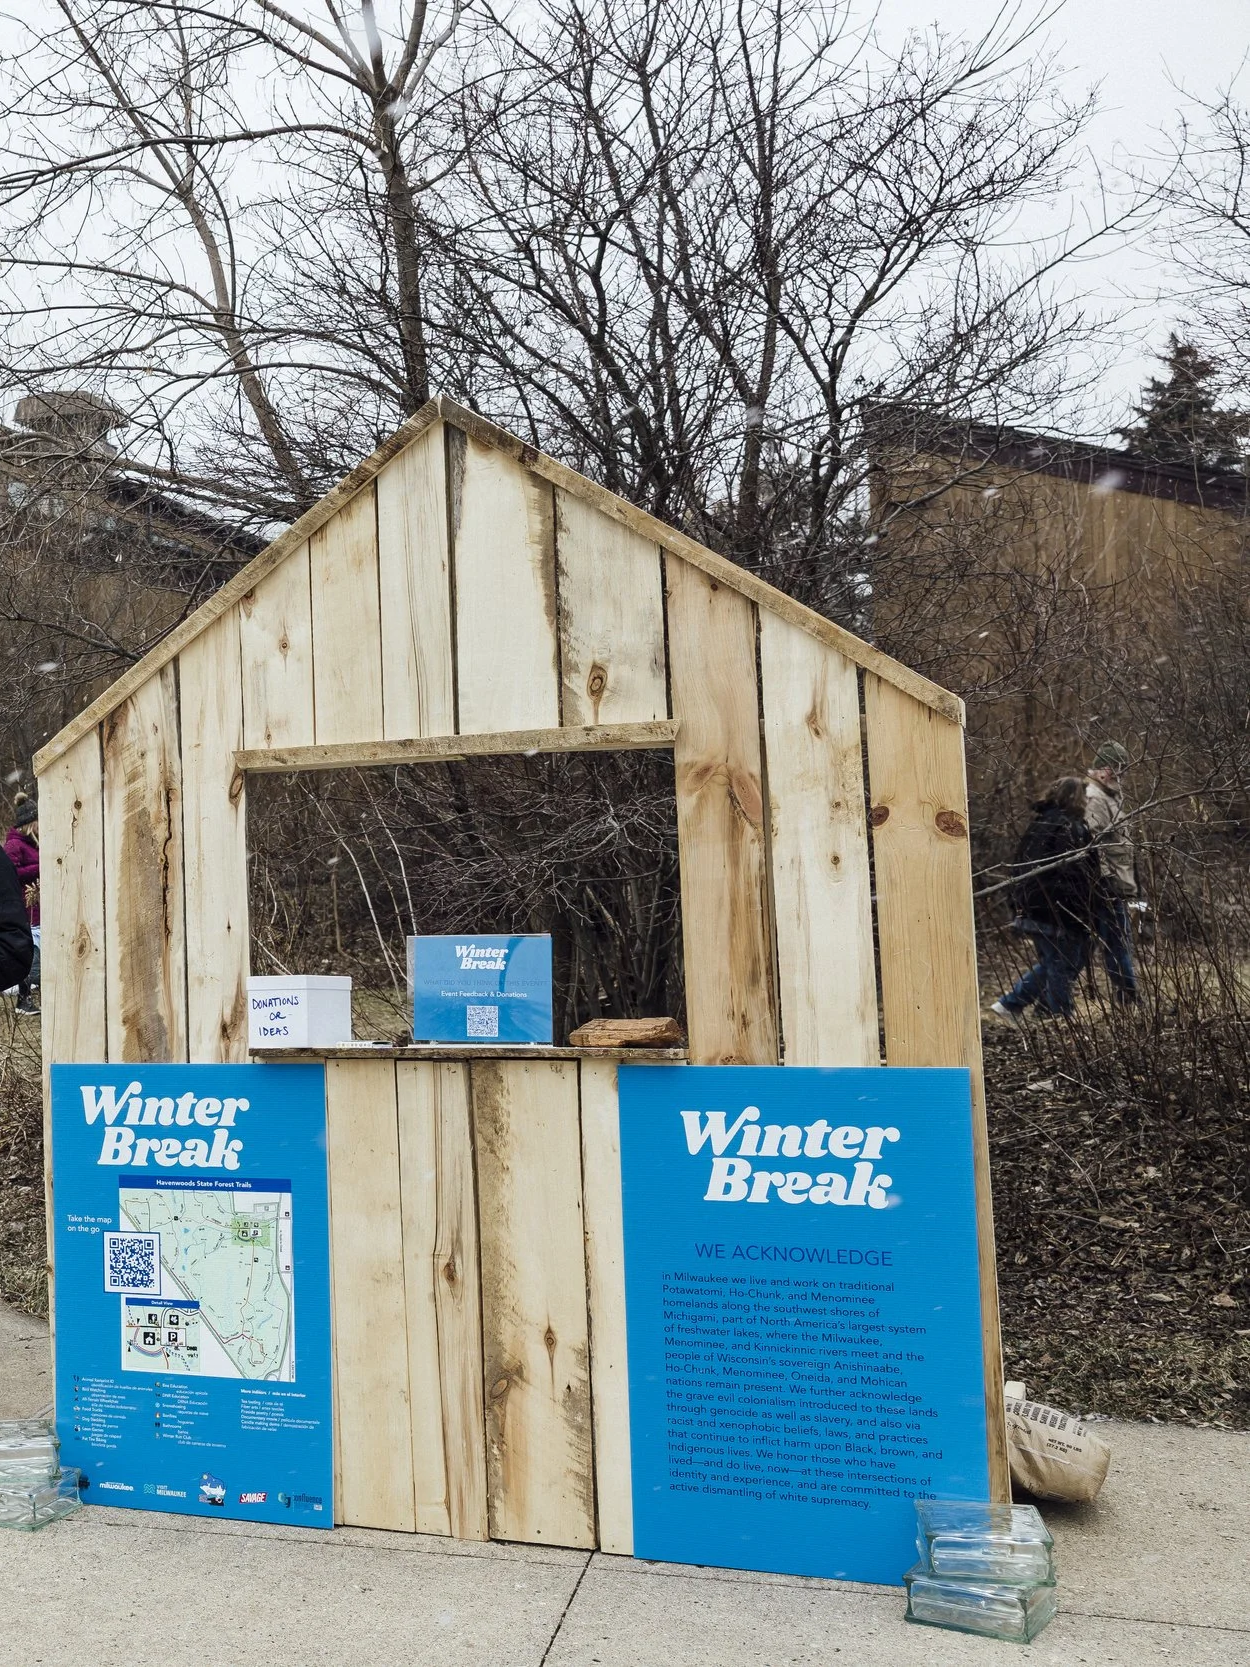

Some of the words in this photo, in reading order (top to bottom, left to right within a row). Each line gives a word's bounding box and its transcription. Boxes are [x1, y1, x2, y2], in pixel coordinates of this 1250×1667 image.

[455, 944, 508, 958] Winter
[460, 958, 507, 970] Break
[252, 996, 299, 1010] DONATIONS
[259, 1026, 289, 1036] IDEAS
[80, 1080, 250, 1126] Winter
[680, 1106, 900, 1160] Winter
[97, 1126, 244, 1170] Break
[703, 1156, 893, 1210] Break
[67, 1214, 82, 1222] Take
[695, 1243, 726, 1259] WE
[732, 1244, 893, 1266] ACKNOWLEDGE
[662, 1284, 725, 1296] Potawatomi,
[729, 1287, 784, 1300] Ho-Chunk,
[787, 1291, 807, 1300] and
[810, 1291, 874, 1303] Menominee
[674, 1271, 728, 1283] Milwaukee
[749, 1275, 766, 1285] live
[770, 1276, 789, 1286] and
[792, 1278, 818, 1287] work
[838, 1280, 894, 1291] traditional
[662, 1297, 718, 1309] homelands
[721, 1300, 750, 1313] along
[753, 1302, 770, 1312] the
[773, 1303, 826, 1315] southwest
[829, 1306, 865, 1317] shores
[868, 1307, 879, 1318] of
[663, 1310, 718, 1324] Michigami,
[722, 1315, 743, 1325] part
[745, 1315, 756, 1324] of
[760, 1316, 790, 1326] North
[848, 1320, 884, 1333] largest
[888, 1324, 926, 1336] system
[663, 1323, 675, 1332] of
[676, 1323, 730, 1335] freshwater
[733, 1327, 762, 1339] lakes,
[765, 1329, 797, 1340] where
[801, 1331, 818, 1341] the
[821, 1333, 882, 1346] Milwaukee,
[664, 1336, 727, 1350] Menominee,
[730, 1340, 750, 1350] and
[753, 1342, 815, 1354] Kinnickinnic
[819, 1346, 847, 1356] rivers
[851, 1350, 878, 1358] meet
[882, 1350, 902, 1360] and
[906, 1351, 924, 1361] the
[664, 1350, 700, 1363] people
[703, 1351, 714, 1361] of
[778, 1357, 830, 1371] sovereign
[833, 1360, 902, 1375] Anishinaabe,
[665, 1362, 718, 1375] Ho-Chunk,
[722, 1366, 787, 1380] Menominee,
[790, 1370, 833, 1383] Oneida,
[836, 1374, 857, 1384] and
[860, 1375, 907, 1387] Mohican
[665, 1376, 702, 1387] nations
[705, 1379, 740, 1389] remain
[743, 1382, 785, 1394] present.
[788, 1384, 806, 1394] We
[809, 1385, 846, 1397] further
[849, 1388, 922, 1404] acknowledge
[666, 1389, 682, 1398] the
[685, 1392, 714, 1402] grave
[717, 1392, 734, 1402] evil
[737, 1394, 795, 1406] colonialism
[799, 1398, 857, 1411] introduced
[860, 1404, 872, 1412] to
[875, 1403, 905, 1415] these
[908, 1405, 938, 1417] lands
[666, 1402, 706, 1416] through
[709, 1405, 758, 1419] genocide
[775, 1410, 796, 1420] well
[813, 1412, 852, 1426] slavery,
[856, 1416, 876, 1426] and
[879, 1417, 902, 1428] also
[905, 1420, 920, 1430] via
[667, 1415, 693, 1426] racist
[696, 1417, 716, 1427] and
[719, 1419, 780, 1434] xenophobic
[783, 1423, 821, 1437] beliefs,
[825, 1427, 850, 1439] laws,
[854, 1429, 874, 1440] and
[878, 1432, 928, 1446] practices
[667, 1428, 687, 1438] that
[690, 1430, 735, 1442] continue
[752, 1435, 780, 1446] inflict
[783, 1437, 810, 1448] harm
[814, 1442, 841, 1453] upon
[845, 1442, 876, 1455] Black,
[880, 1445, 918, 1458] brown,
[921, 1448, 942, 1459] and
[668, 1441, 724, 1456] Indigenous
[727, 1446, 752, 1457] lives.
[755, 1448, 773, 1459] We
[776, 1450, 808, 1462] honor
[810, 1453, 840, 1464] those
[843, 1456, 866, 1466] who
[870, 1458, 895, 1469] have
[669, 1467, 707, 1481] identity
[710, 1471, 729, 1481] and
[732, 1473, 793, 1489] experience,
[796, 1478, 817, 1489] and
[820, 1483, 837, 1491] are
[840, 1483, 899, 1497] committed
[903, 1489, 915, 1498] to
[918, 1489, 936, 1500] the
[726, 1459, 740, 1469] do
[743, 1461, 763, 1472] live,
[814, 1467, 844, 1478] these
[847, 1469, 916, 1484] intersections
[919, 1475, 931, 1486] of
[156, 1490, 187, 1498] MILWAUKEE
[240, 1493, 266, 1502] SAVAGE
[669, 1481, 699, 1492] active
[702, 1484, 762, 1500] dismantling
[765, 1489, 776, 1499] of
[778, 1490, 808, 1502] white
[810, 1496, 871, 1510] supremacy.
